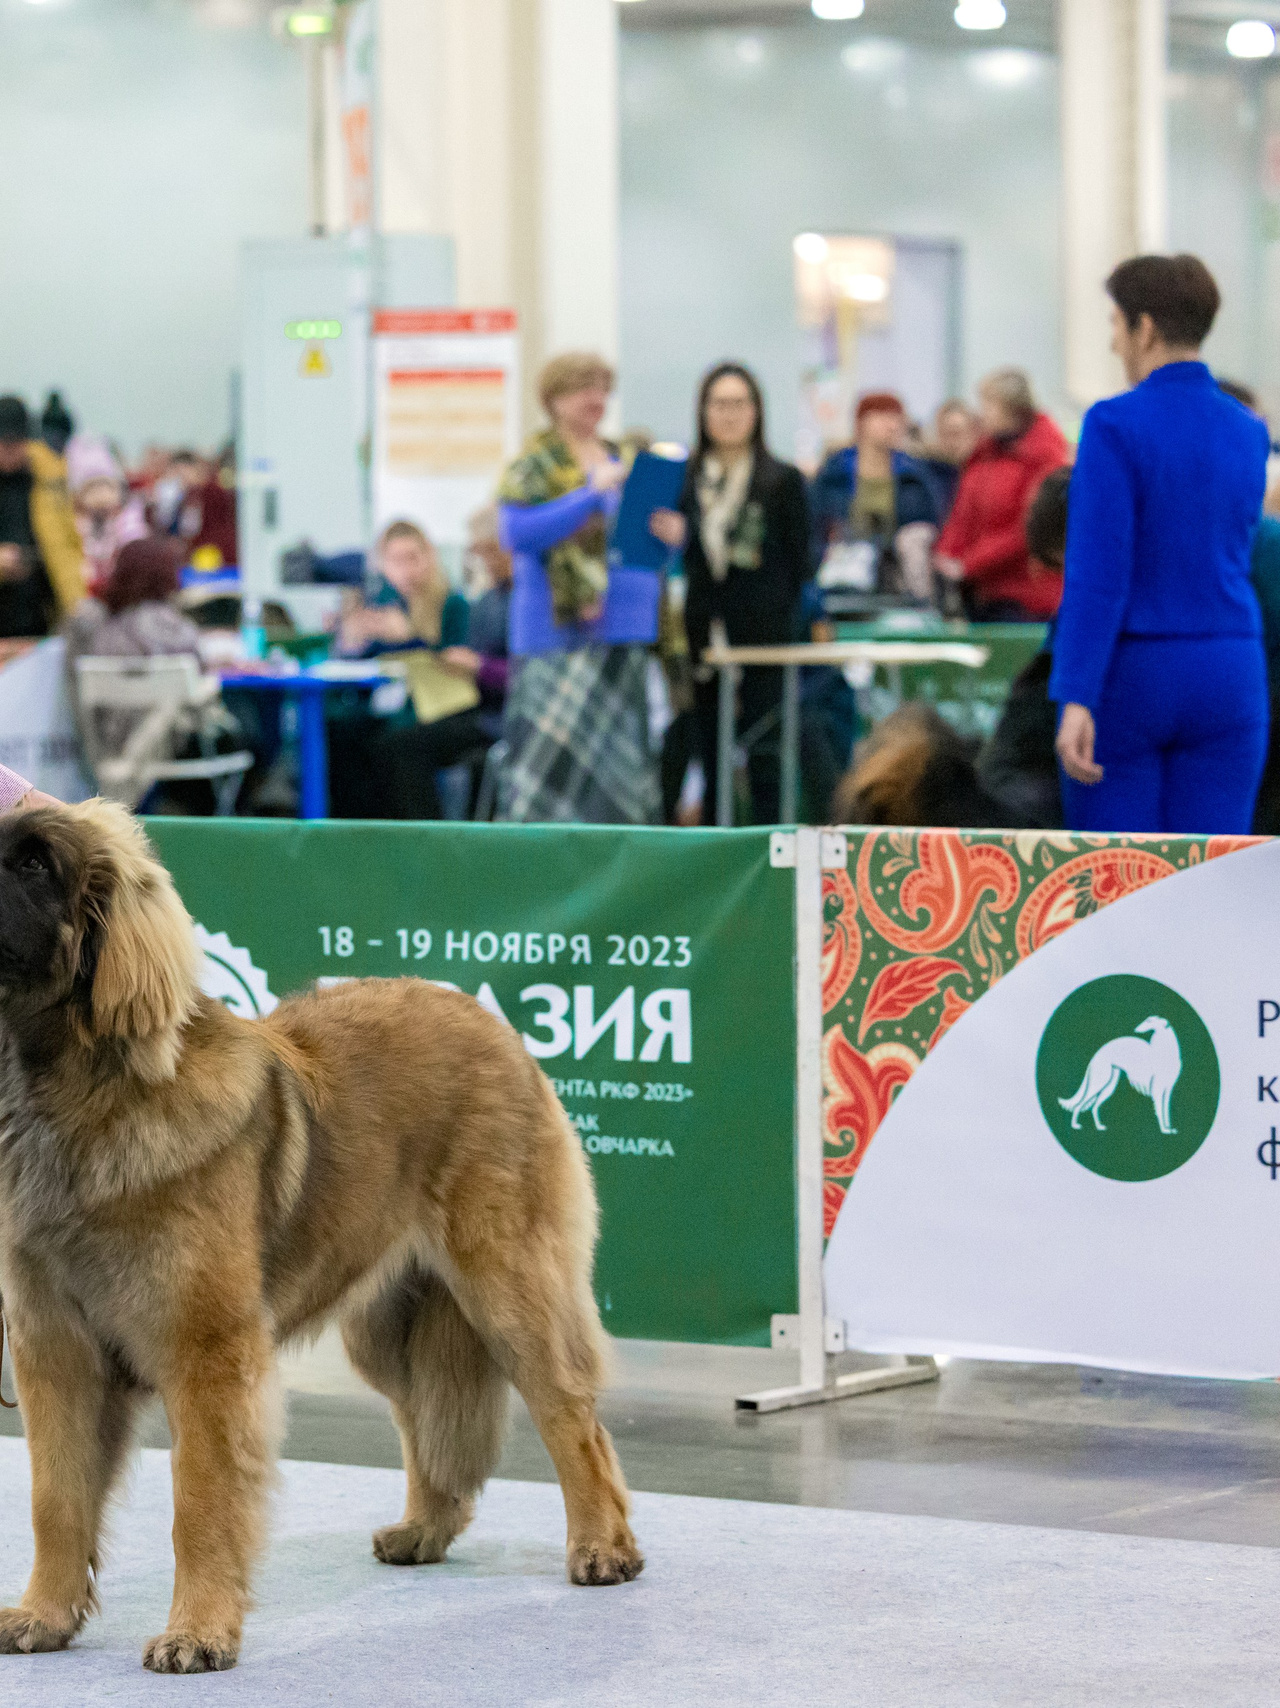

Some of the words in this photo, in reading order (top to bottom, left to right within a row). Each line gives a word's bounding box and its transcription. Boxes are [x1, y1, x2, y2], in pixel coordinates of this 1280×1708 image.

[318, 926, 354, 957] 18
[396, 928, 432, 960] 19
[445, 930, 592, 965] НОЯБРЯ
[606, 934, 692, 967] 2023
[586, 1135, 675, 1156] ОВЧАРКА
